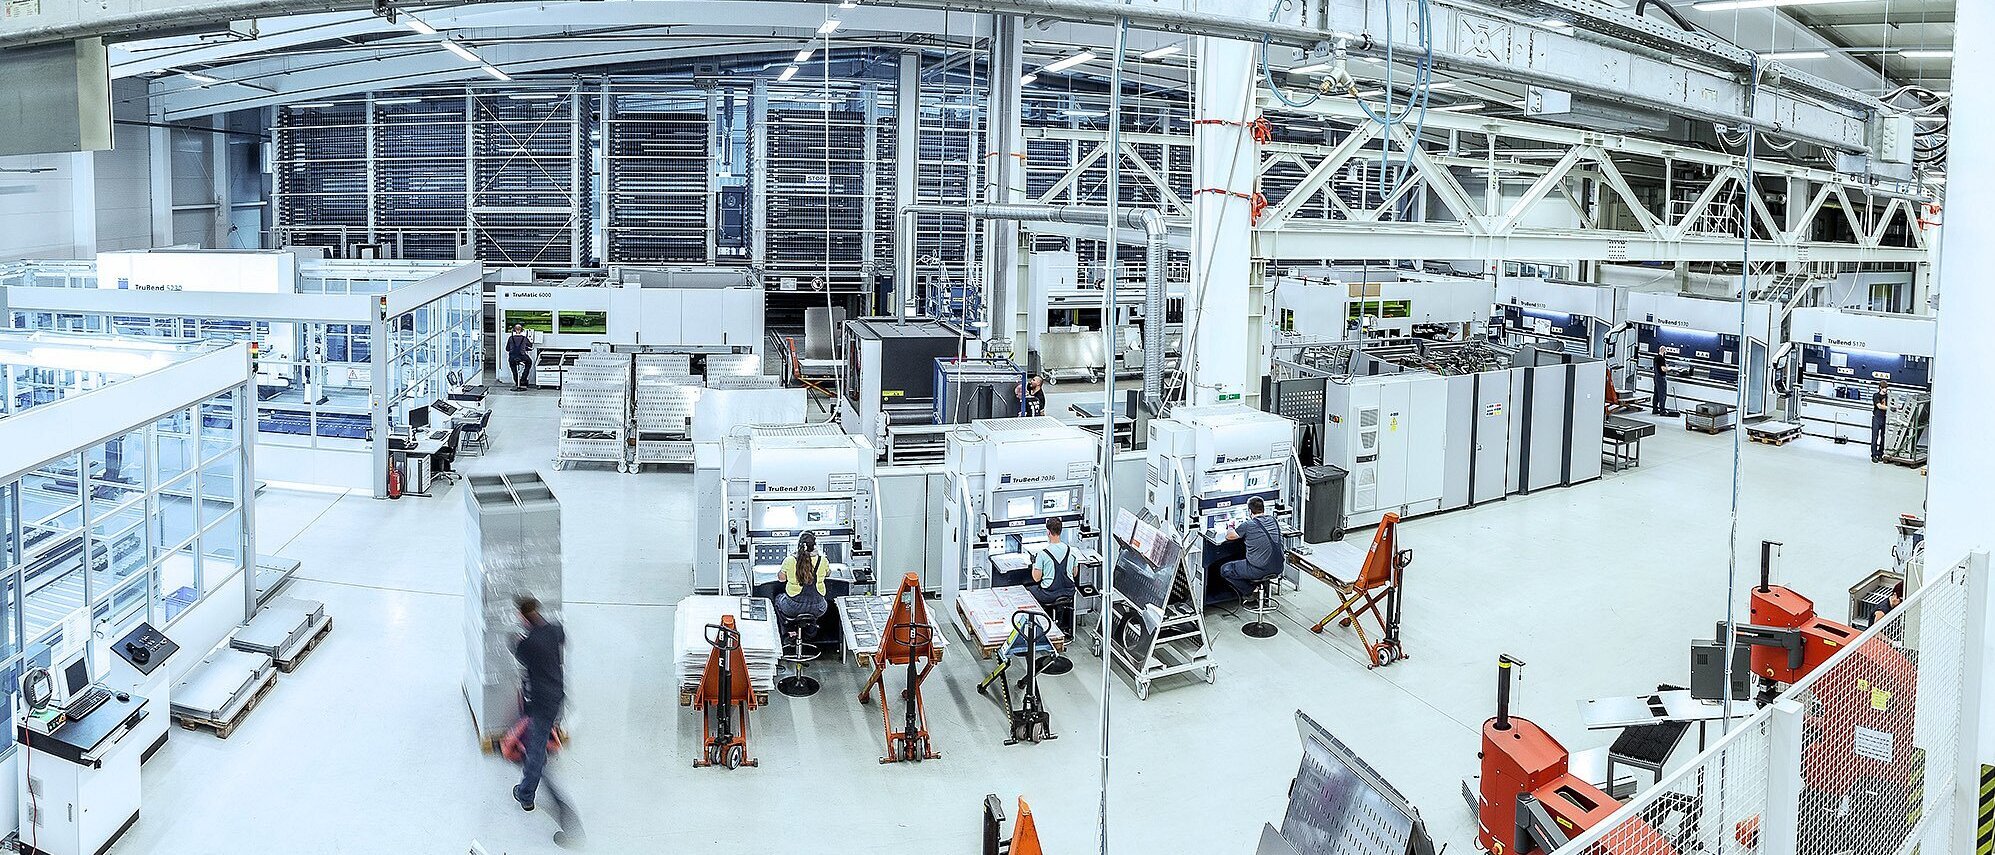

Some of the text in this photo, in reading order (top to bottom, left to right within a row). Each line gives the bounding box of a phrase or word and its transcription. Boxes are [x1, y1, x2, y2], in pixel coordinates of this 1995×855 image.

[1658, 318, 1677, 326] TruBend
[1828, 338, 1852, 346] TruBend
[1226, 455, 1249, 463] TruBend
[1013, 475, 1040, 483] TruBend
